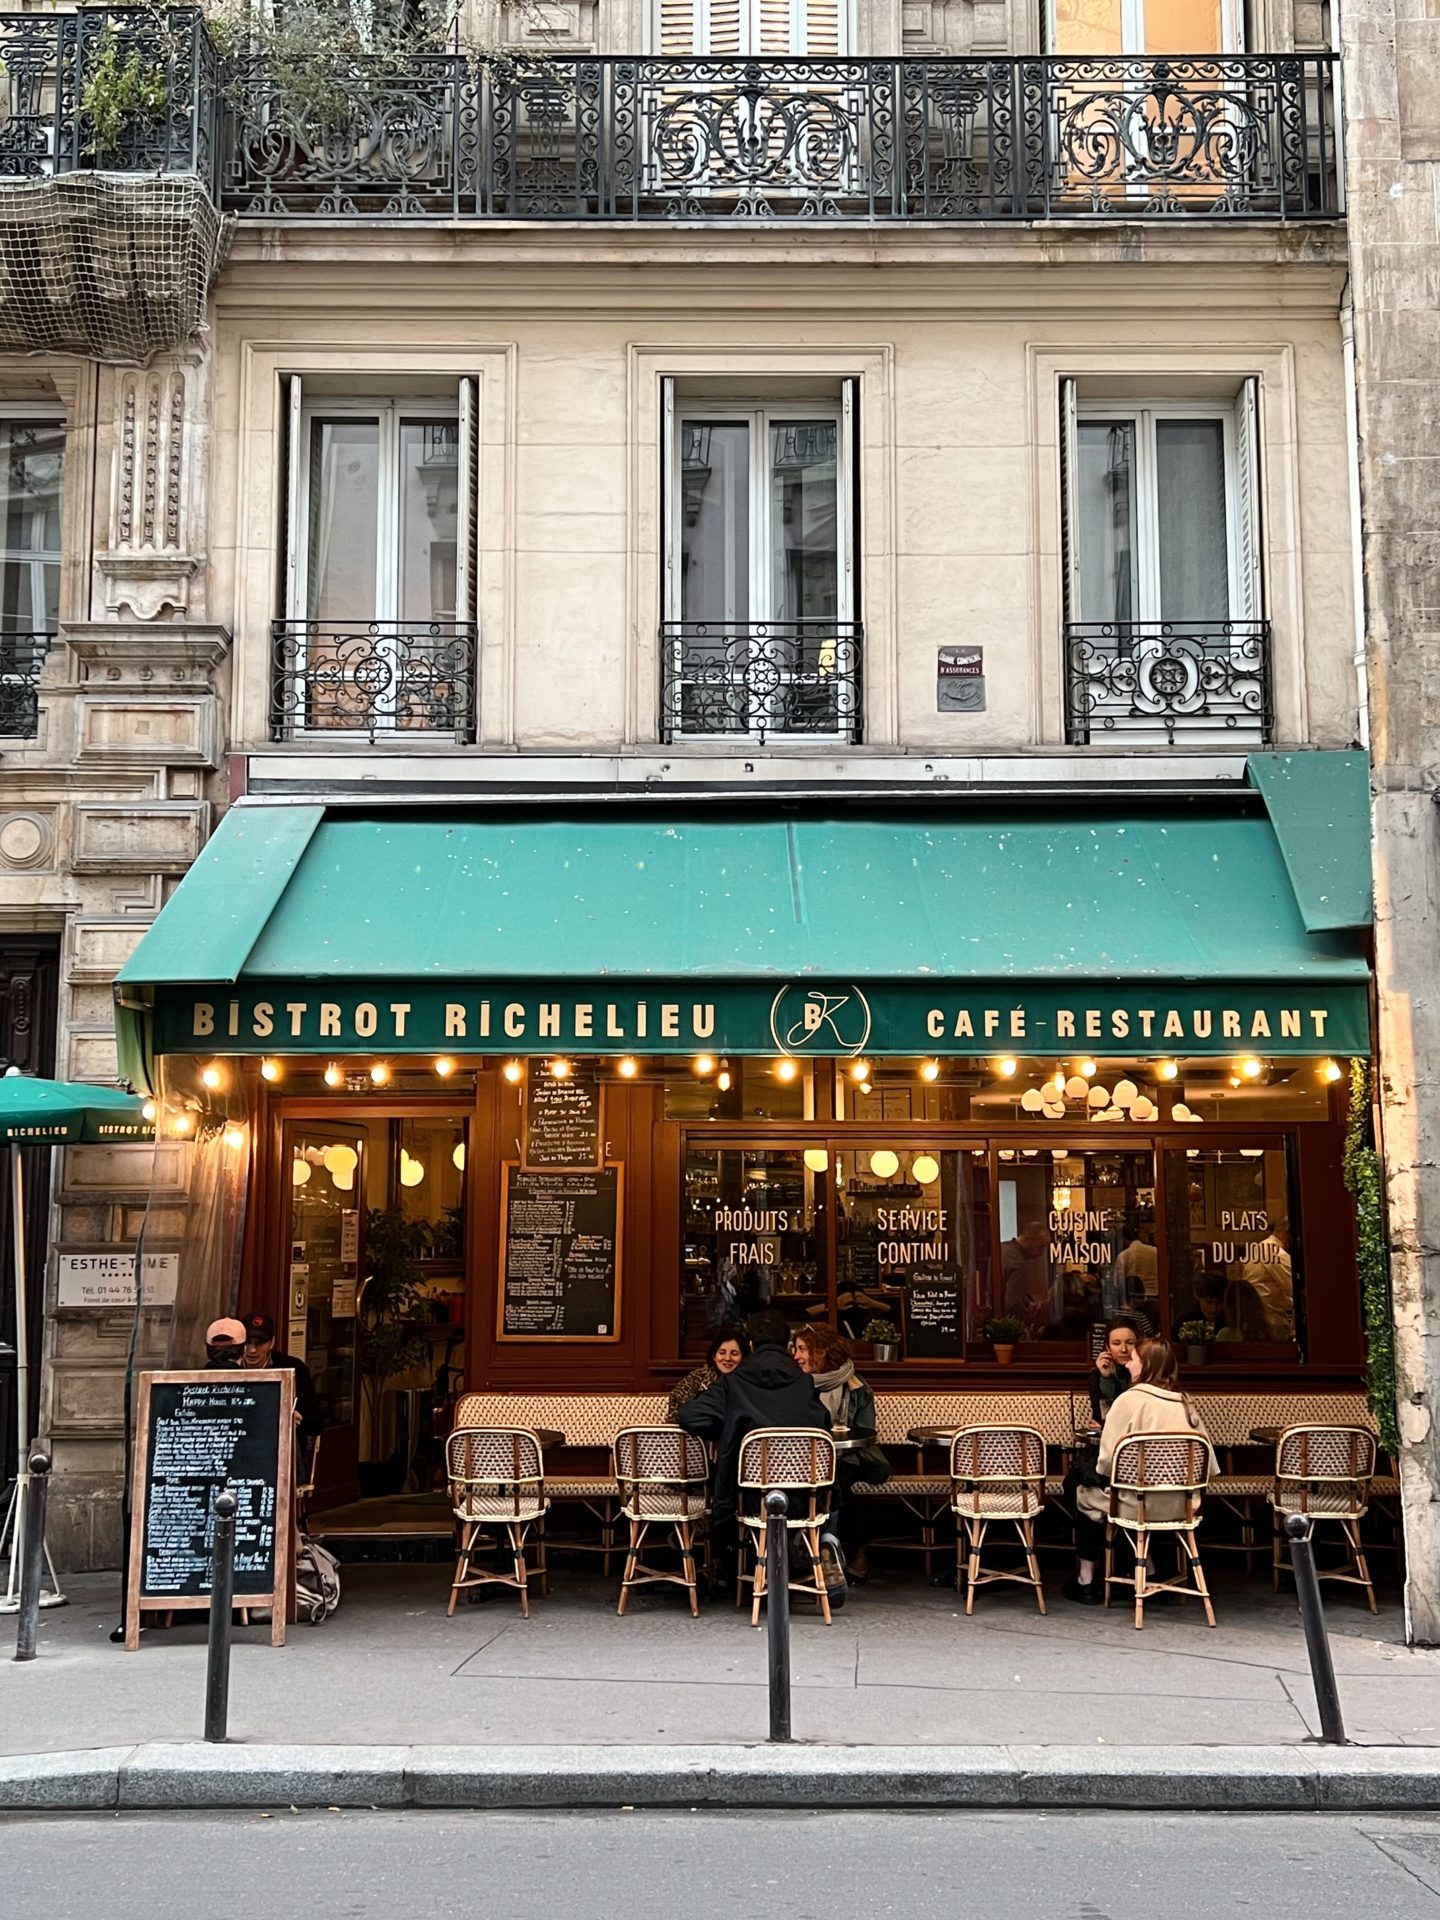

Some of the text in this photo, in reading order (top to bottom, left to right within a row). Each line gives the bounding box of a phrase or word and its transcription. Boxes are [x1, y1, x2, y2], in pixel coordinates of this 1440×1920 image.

[7, 1126, 68, 1137] RICHELIEU
[99, 1125, 138, 1134] BISTROT
[715, 1210, 788, 1231] PRODUITS
[877, 1210, 948, 1231] SERVICE
[1049, 1211, 1109, 1232] CUISINE
[1221, 1211, 1268, 1231] PLATS
[70, 1257, 169, 1270] ESTHE-TME
[730, 1243, 774, 1265] FRAIS
[1050, 1242, 1111, 1264] MAISON
[1212, 1242, 1281, 1264] DU JOUR
